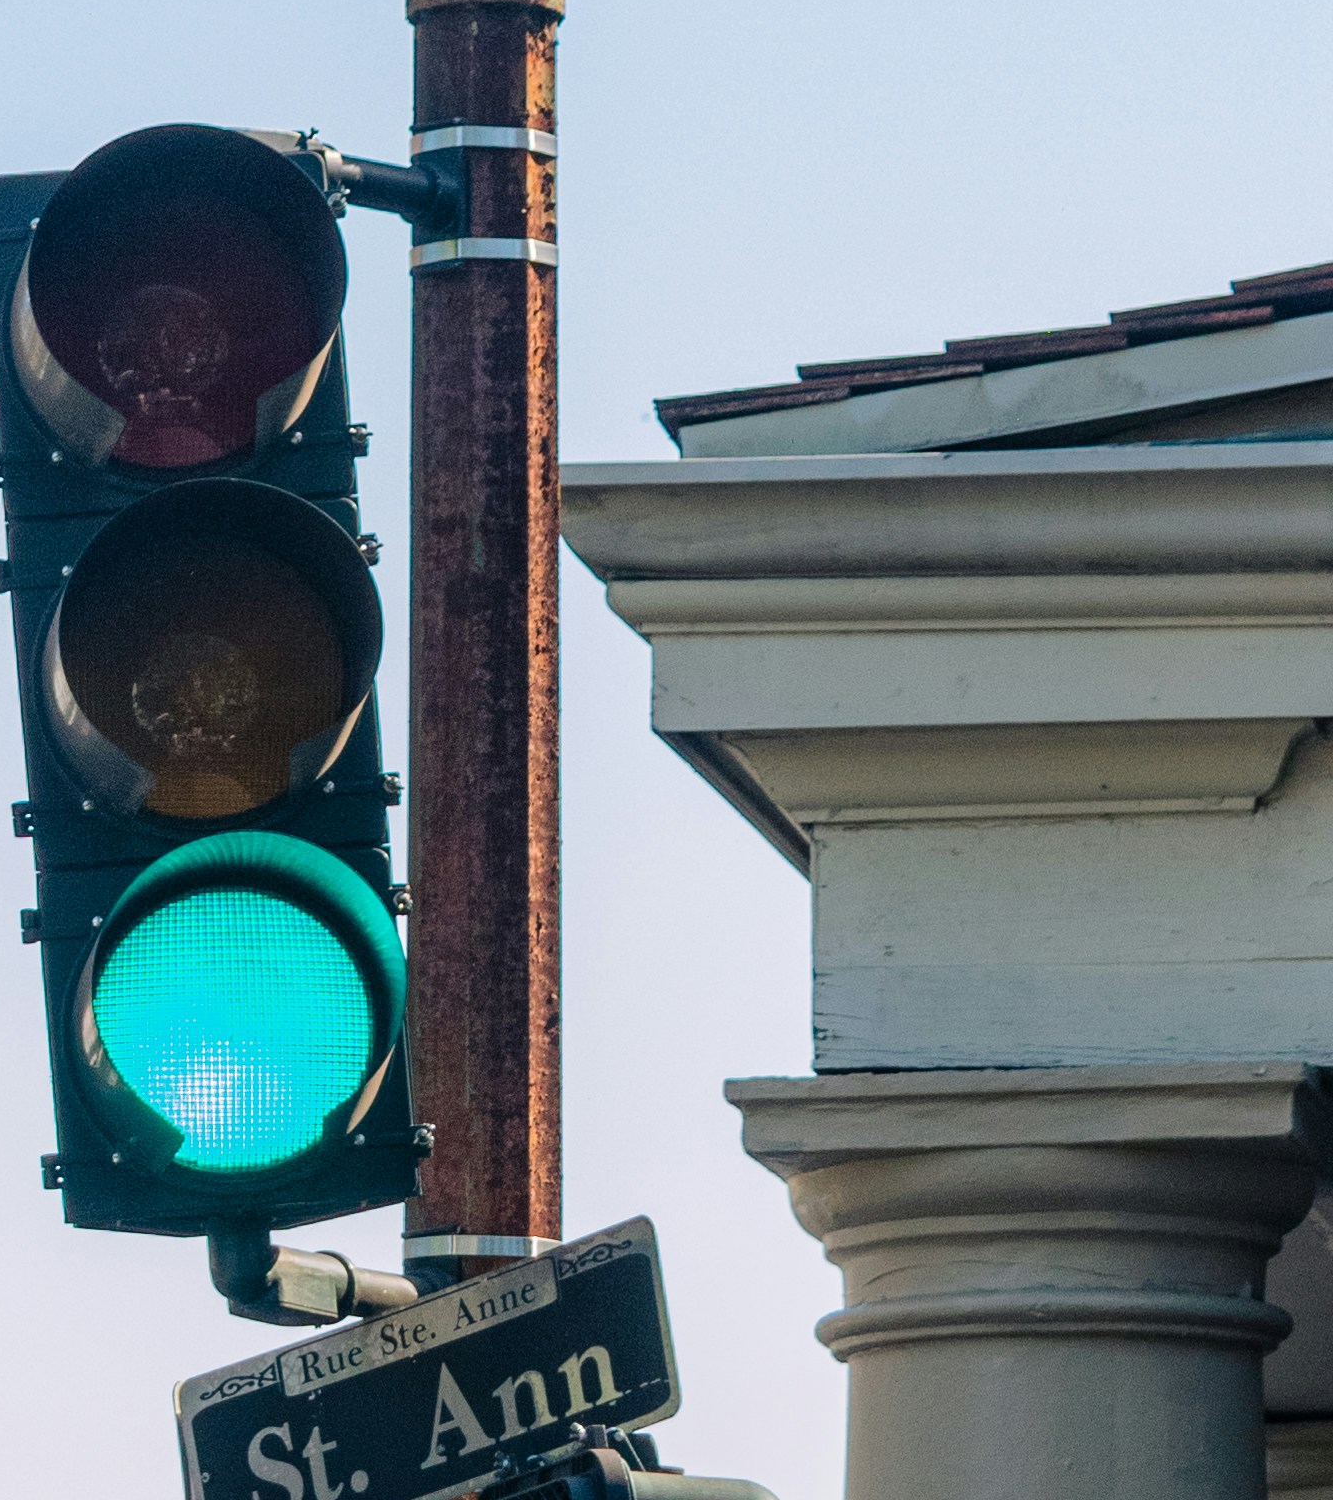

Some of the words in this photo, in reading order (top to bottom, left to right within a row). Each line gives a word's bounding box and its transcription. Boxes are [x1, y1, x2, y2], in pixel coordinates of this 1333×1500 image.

[299, 1346, 364, 1386] Rue
[379, 1322, 437, 1358] Ste.
[452, 1280, 537, 1332] Anne
[420, 1343, 625, 1471] Ann
